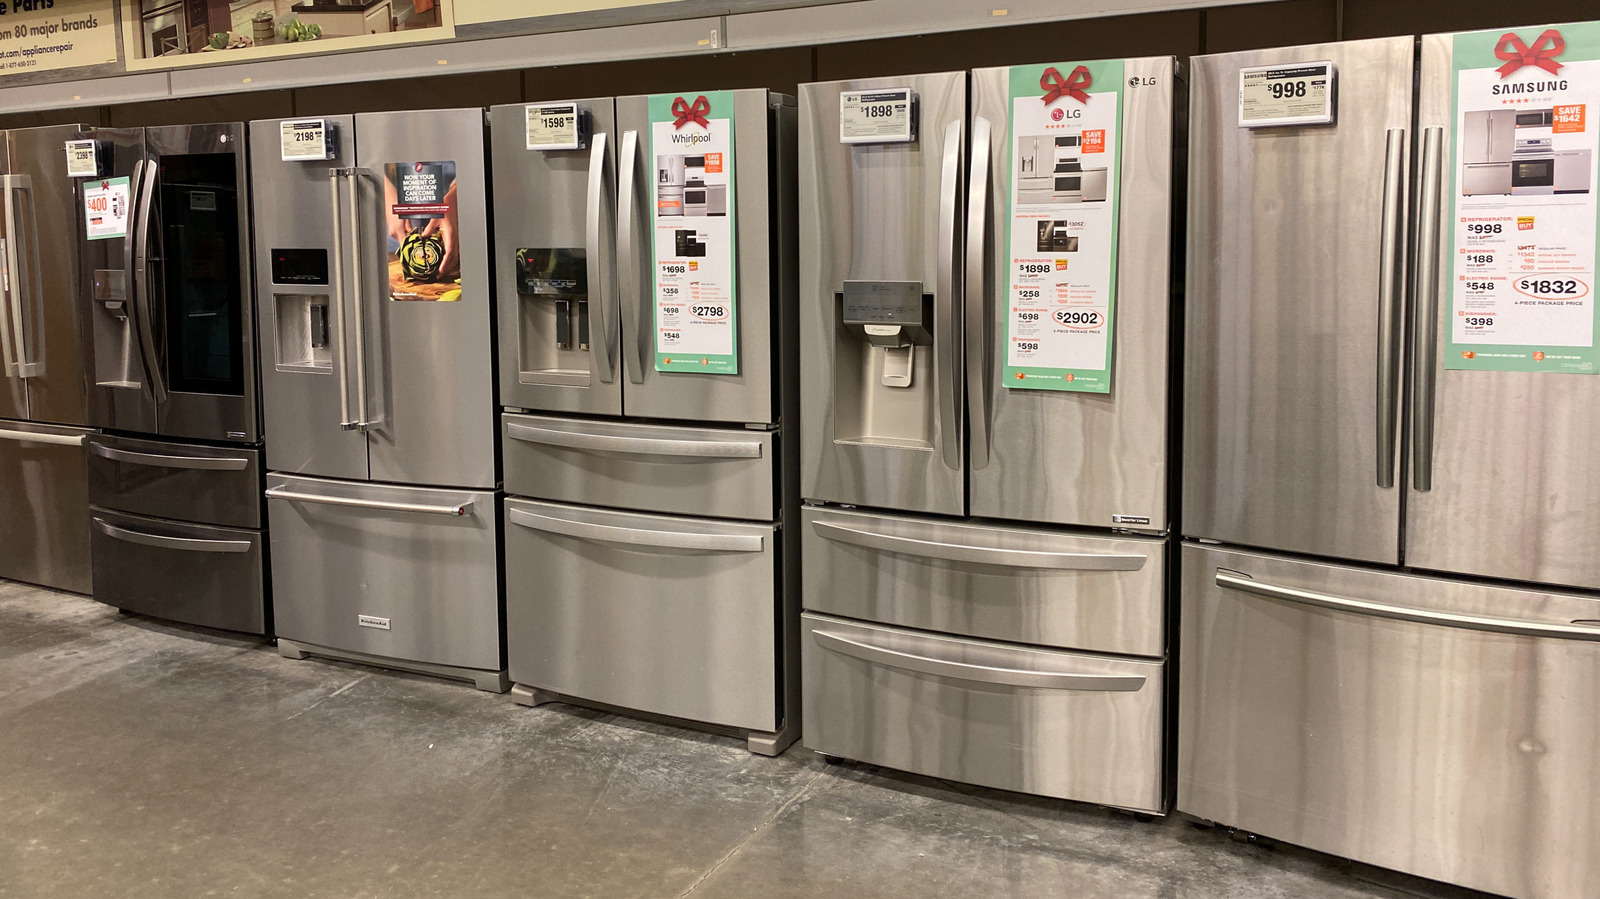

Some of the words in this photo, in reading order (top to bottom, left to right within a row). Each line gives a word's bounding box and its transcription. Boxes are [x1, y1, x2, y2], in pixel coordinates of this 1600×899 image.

[14, 24, 27, 38] 80
[30, 21, 59, 38] major
[62, 14, 98, 32] brands
[1142, 77, 1156, 86] LG
[1268, 81, 1306, 99] $998
[1492, 80, 1568, 95] SAMSUNG
[861, 105, 892, 117] $1898
[1066, 109, 1081, 119] LG
[1558, 106, 1581, 115] SAVE
[541, 117, 564, 128] $1598
[1554, 115, 1580, 123] $1642
[293, 132, 314, 141] $2198
[671, 133, 711, 145] Whirlpool
[88, 197, 107, 211] $400
[1467, 224, 1502, 234] $998
[1467, 255, 1493, 263] $188
[1020, 264, 1050, 273] $1898
[1521, 280, 1577, 294] $1832
[692, 306, 723, 316] $2798
[1057, 312, 1098, 324] $2902
